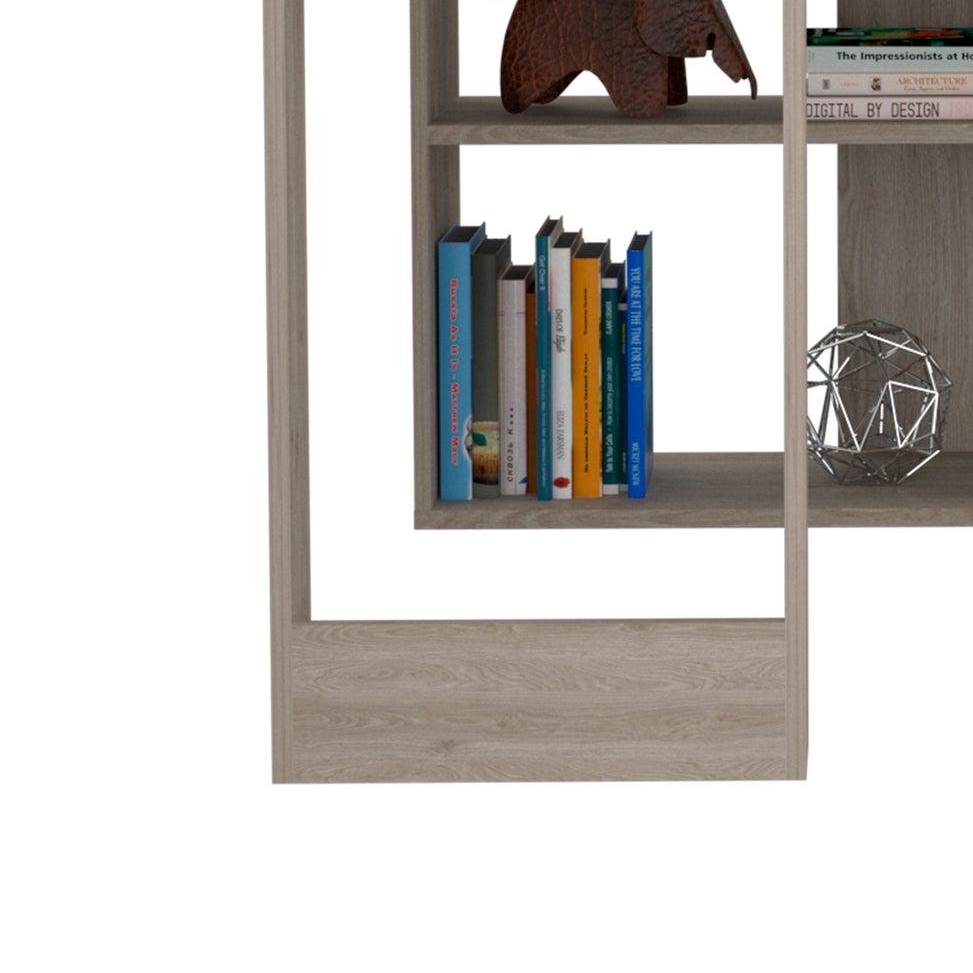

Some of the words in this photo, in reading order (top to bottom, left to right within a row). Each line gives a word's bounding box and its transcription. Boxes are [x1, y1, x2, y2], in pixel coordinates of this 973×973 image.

[836, 51, 857, 60] The
[860, 51, 943, 62] Impressionists
[946, 51, 958, 60] at
[896, 77, 967, 85] ARCHITECTURE
[806, 103, 858, 117] DIGITAL
[867, 103, 882, 117] BY
[891, 103, 940, 118] DESIGN
[631, 267, 641, 283] YOU
[631, 284, 641, 298] ARE
[631, 300, 641, 309] AT
[555, 308, 564, 324] DAYS
[631, 310, 641, 326] THE
[451, 325, 458, 340] As
[555, 324, 564, 333] OF
[631, 327, 641, 345] TIME
[451, 345, 458, 355] It
[551, 334, 567, 354] Elijah
[631, 346, 641, 361] FOR
[451, 359, 458, 370] Is
[631, 362, 641, 381] LOVE
[557, 410, 565, 428] ELIZA
[557, 429, 565, 459] EARSMAN
[632, 442, 640, 464] MICKEY
[506, 442, 514, 482] СКВОЗЬ
